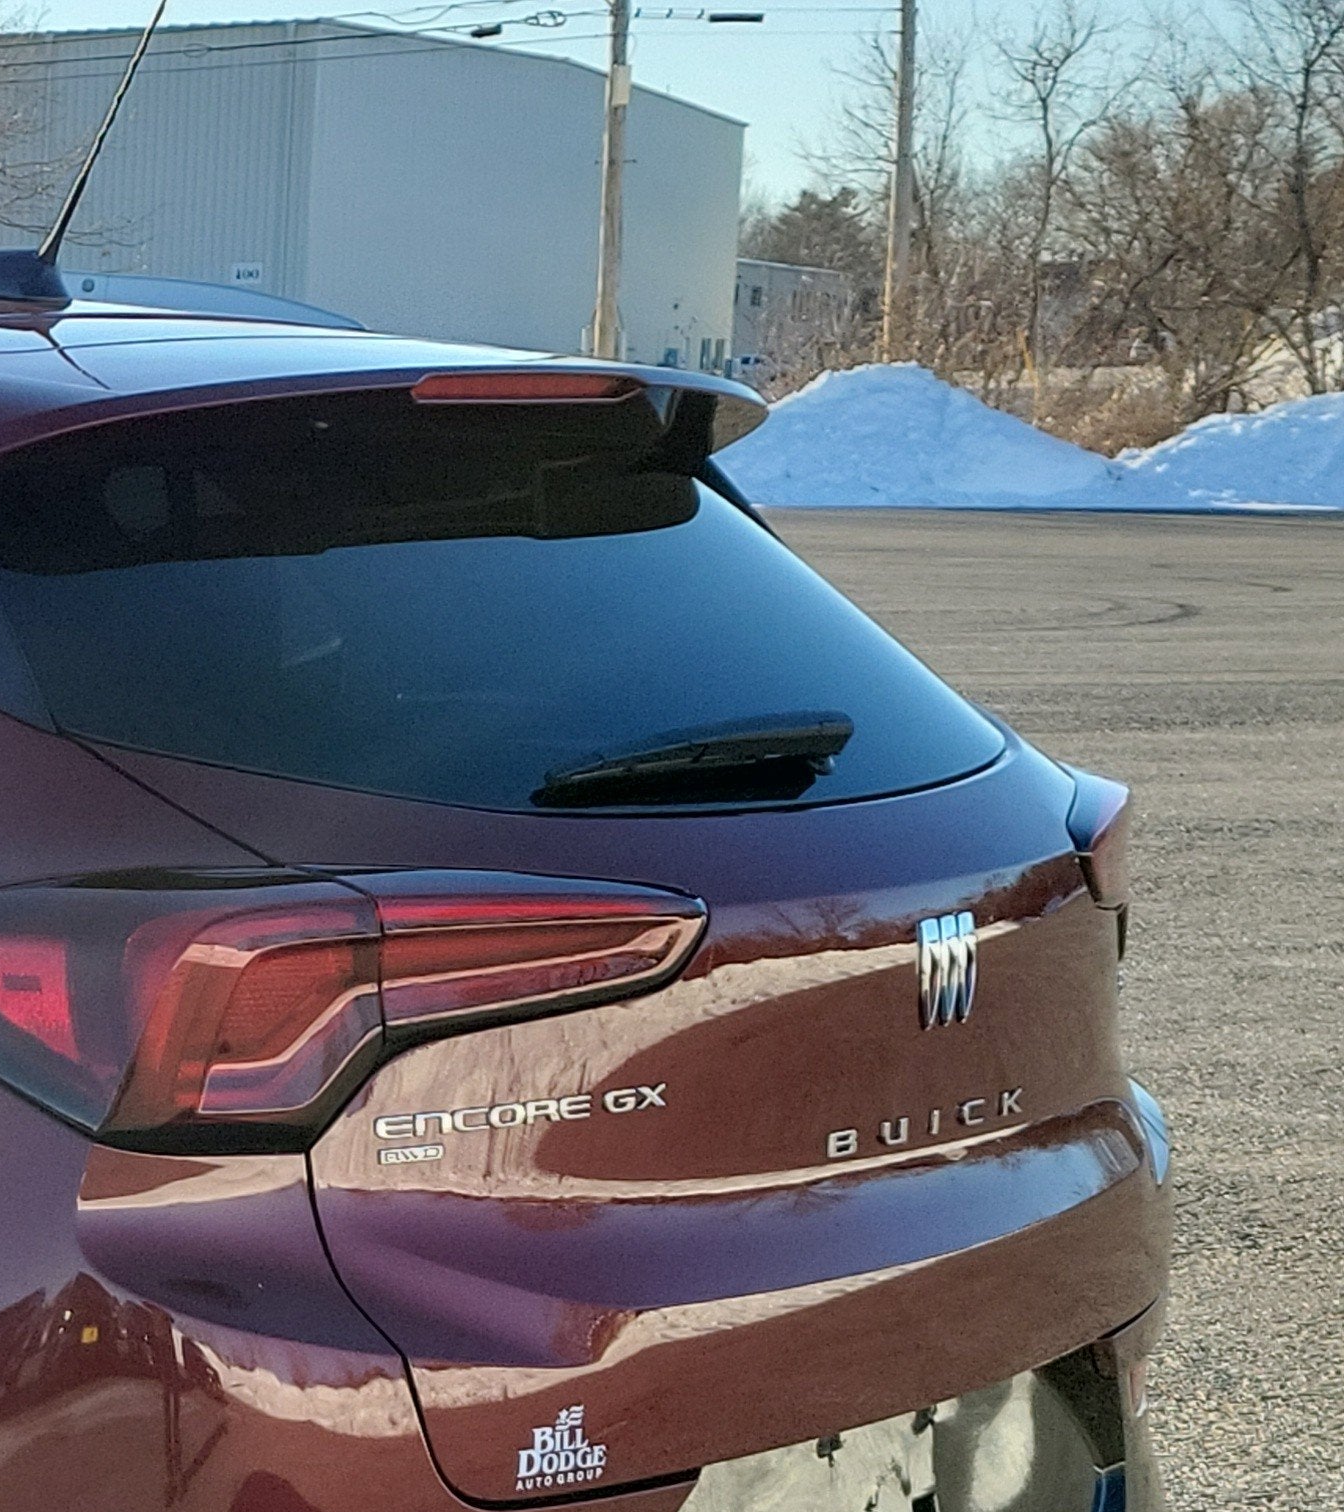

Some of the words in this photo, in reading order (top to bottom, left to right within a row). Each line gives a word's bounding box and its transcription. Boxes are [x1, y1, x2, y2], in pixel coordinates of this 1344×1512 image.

[374, 1095, 592, 1139] ENCORE
[603, 1083, 667, 1113] GX
[827, 1087, 1023, 1158] BUICK
[382, 1145, 442, 1163] AWD
[532, 1426, 589, 1455] BILL
[517, 1444, 607, 1478] DODGE
[515, 1476, 553, 1491] AUTO
[556, 1467, 603, 1485] GROUP
